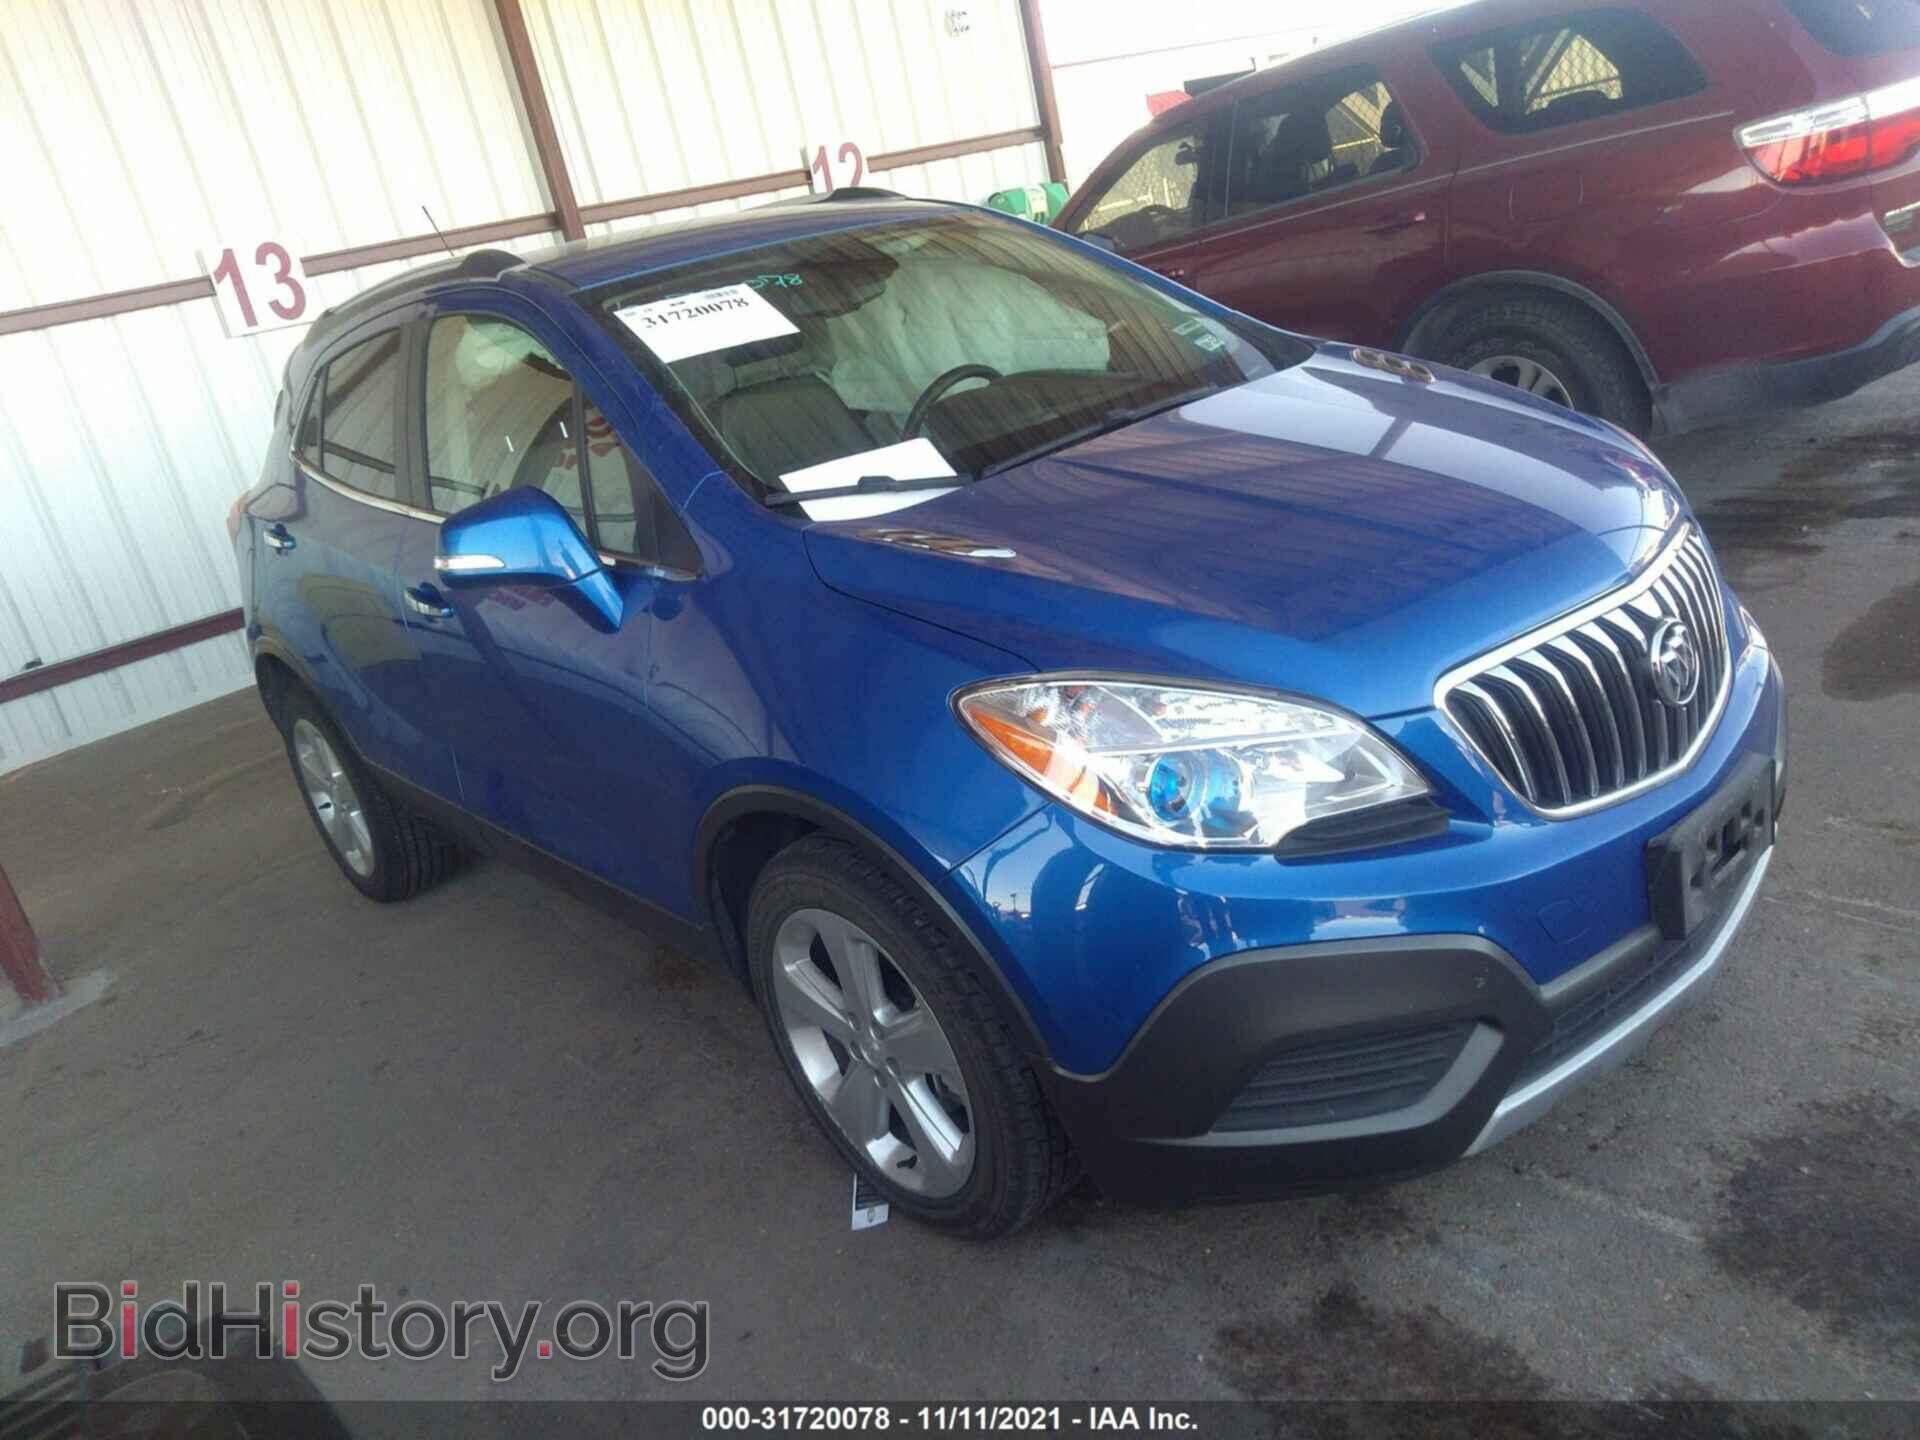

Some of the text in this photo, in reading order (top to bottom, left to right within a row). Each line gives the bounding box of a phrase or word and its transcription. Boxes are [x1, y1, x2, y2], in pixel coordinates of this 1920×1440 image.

[812, 142, 863, 192] 12
[213, 242, 306, 327] 13
[642, 298, 749, 328] 31720078
